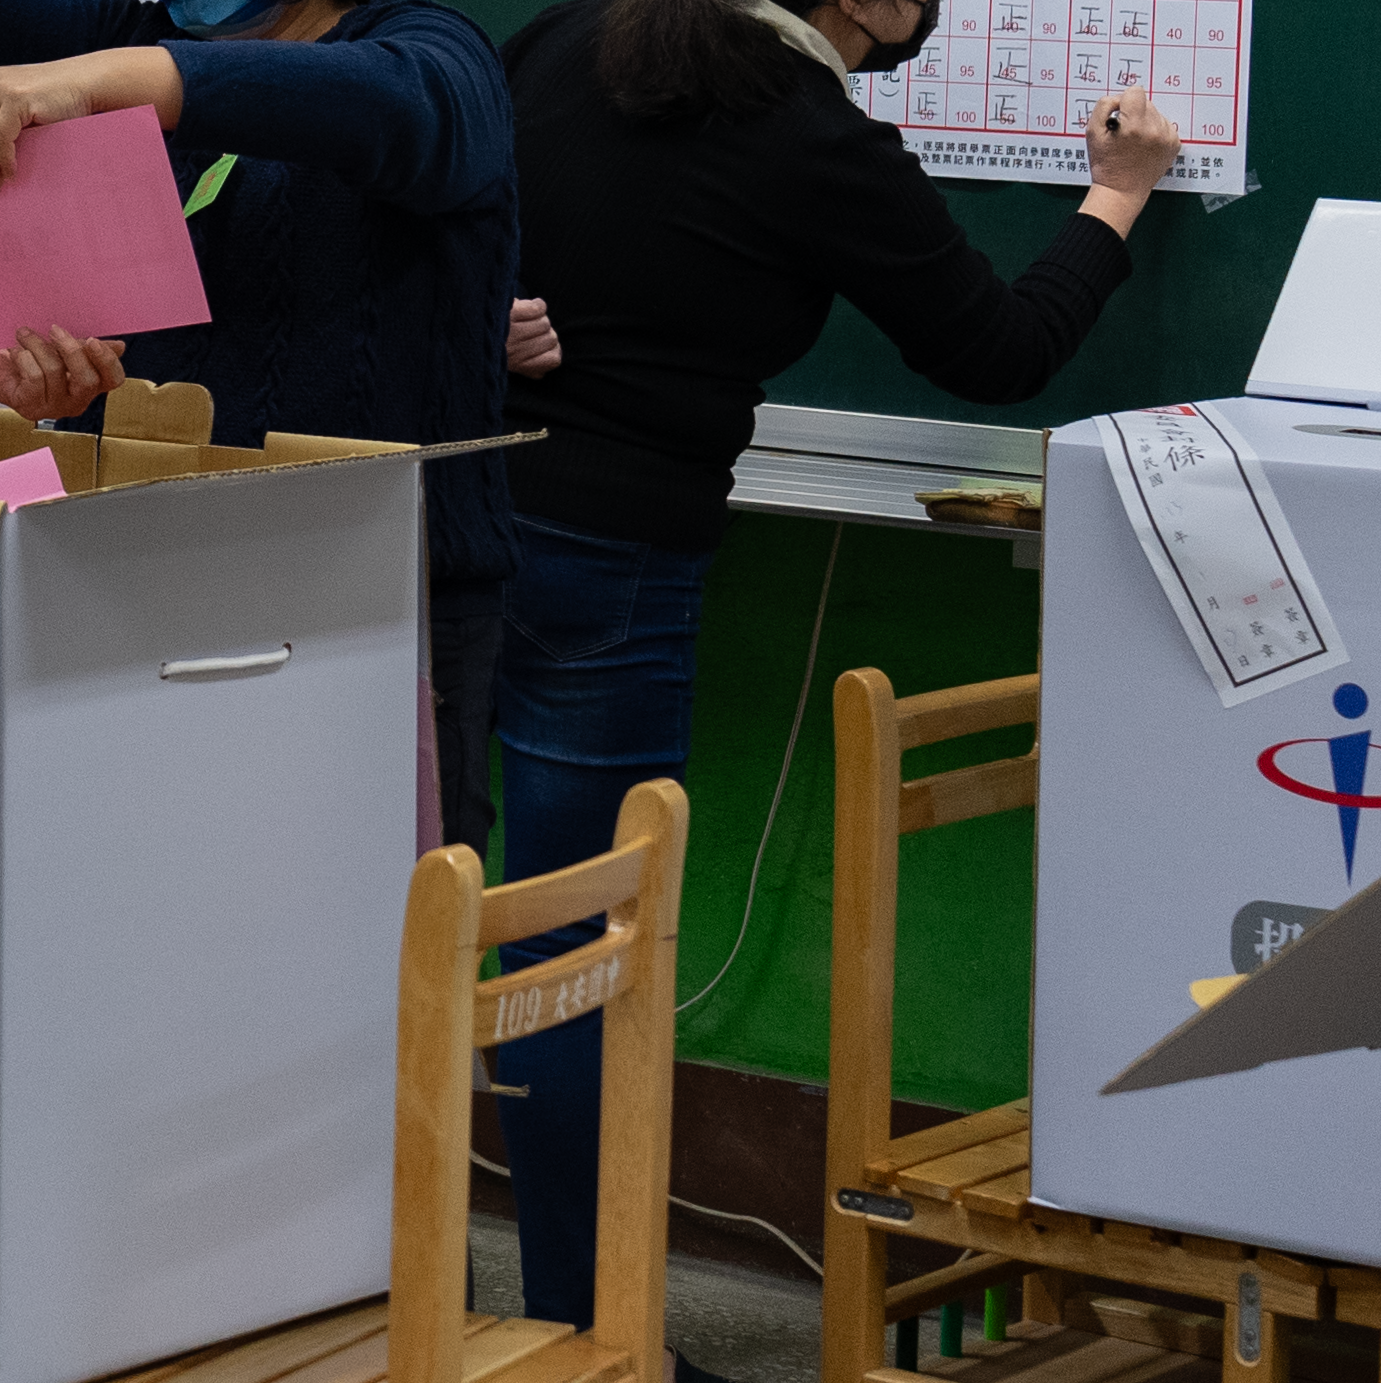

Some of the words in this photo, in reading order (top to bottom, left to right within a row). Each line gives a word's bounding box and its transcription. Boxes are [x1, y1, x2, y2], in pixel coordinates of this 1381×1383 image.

[962, 20, 976, 30] 90
[1043, 23, 1056, 34] 90
[1167, 28, 1182, 40] 40
[1209, 29, 1224, 42] 90
[960, 65, 975, 77] 95
[1041, 69, 1054, 80] 95
[1122, 73, 1140, 87] 95
[1165, 75, 1180, 86] 45
[1206, 77, 1222, 89] 95
[956, 111, 977, 123] 100
[1037, 115, 1056, 127] 100
[1203, 124, 1224, 136] 100
[494, 986, 542, 1040] 109
